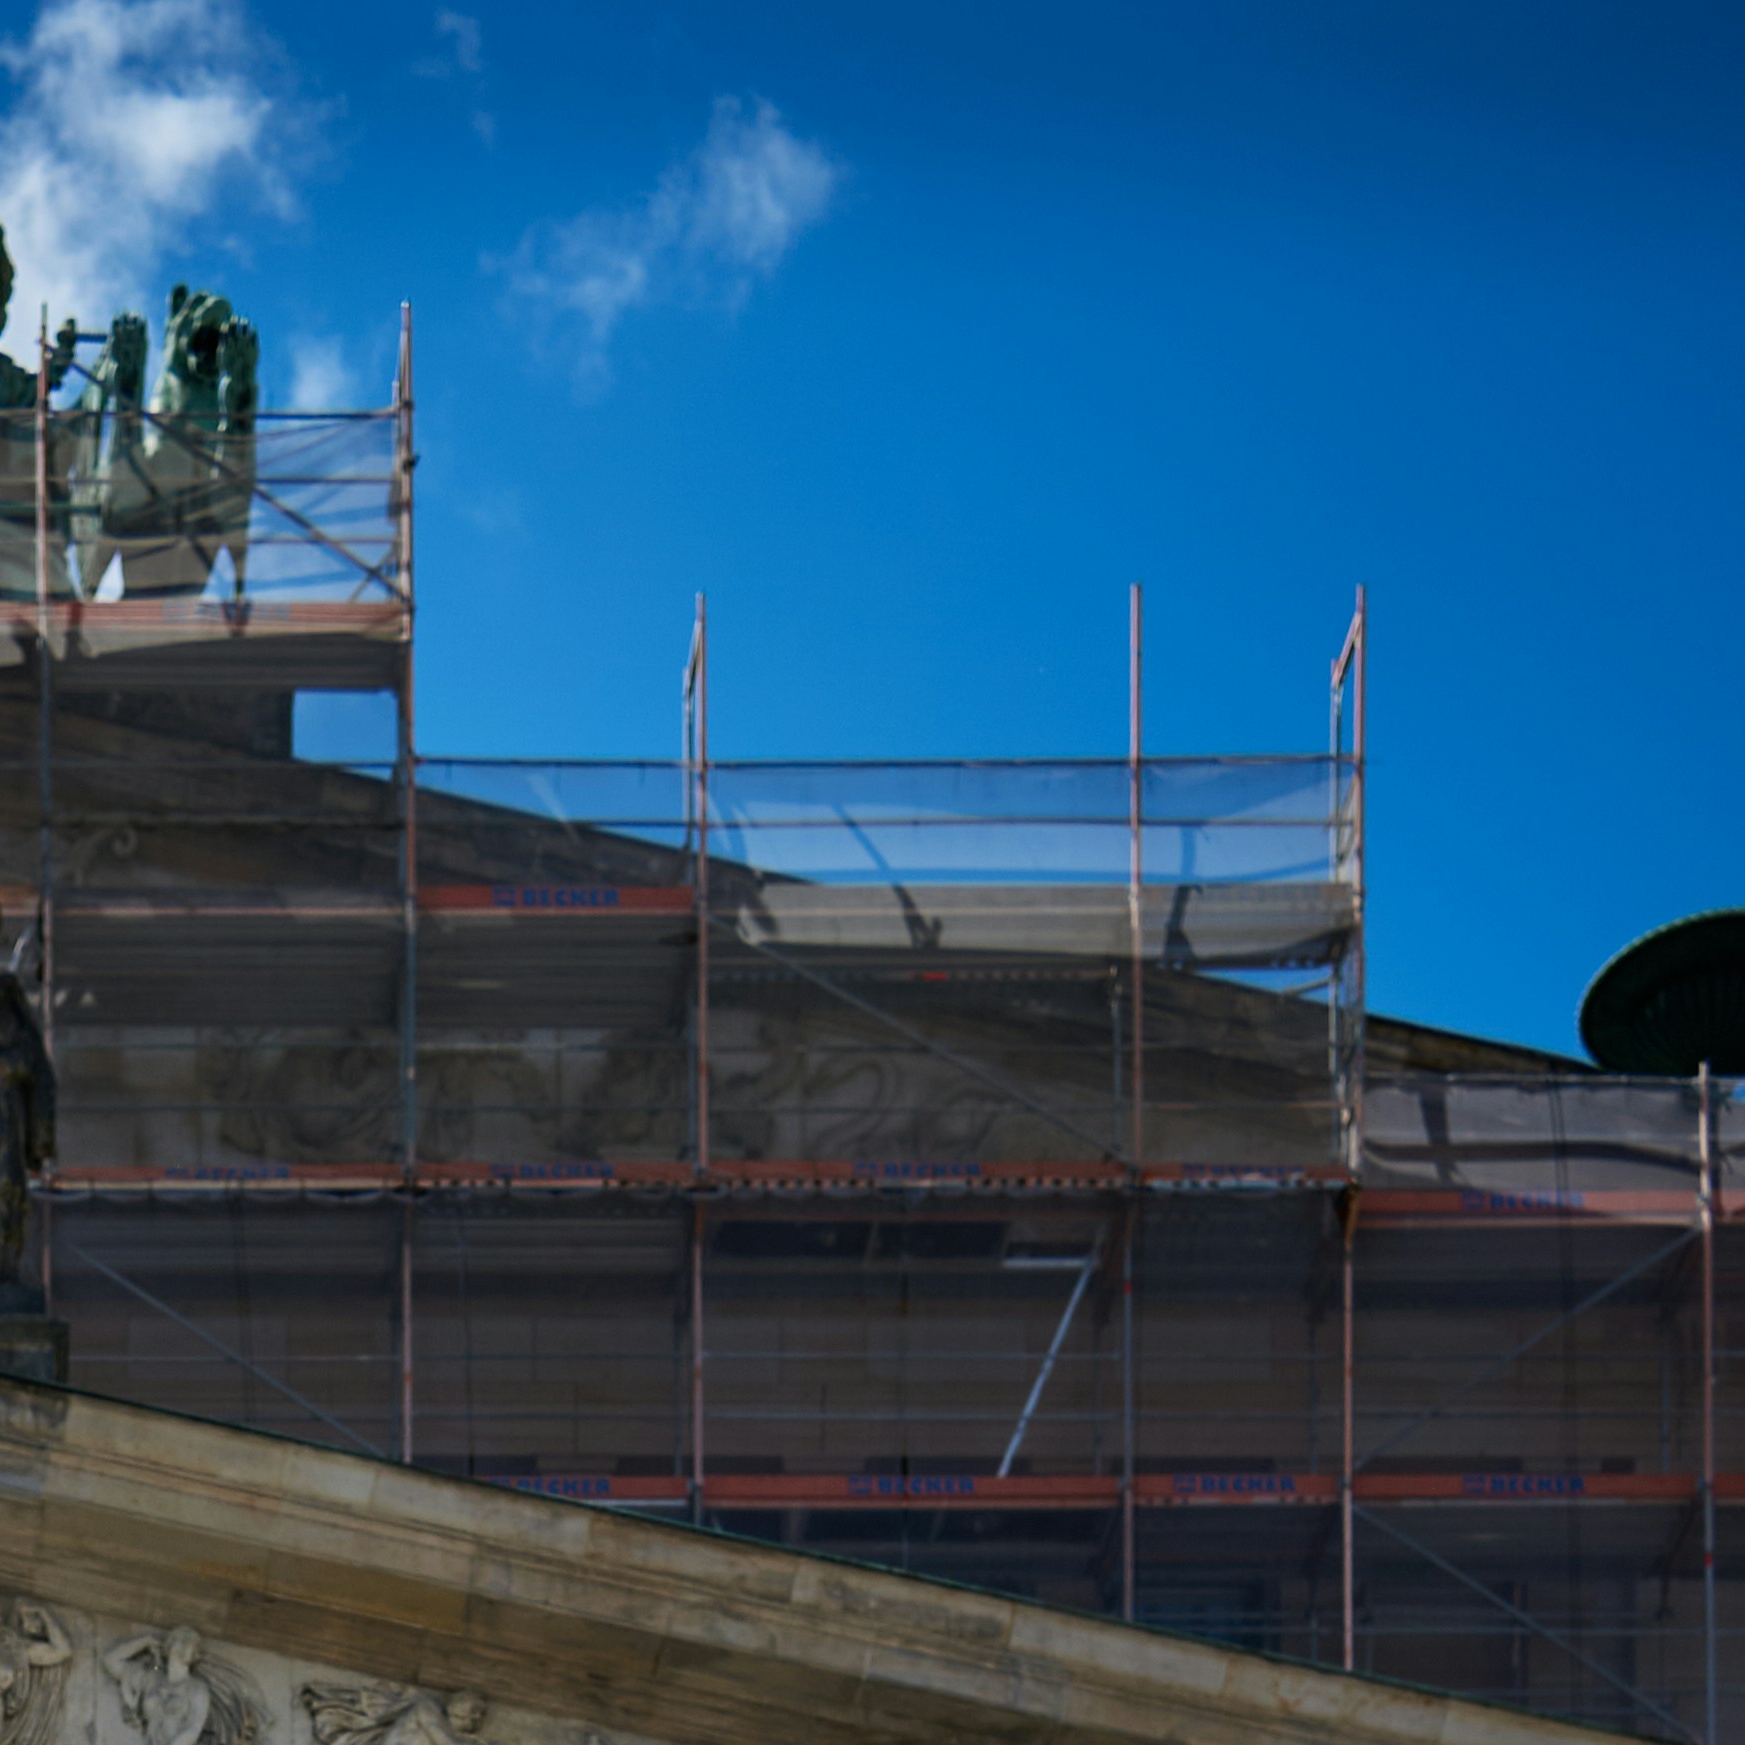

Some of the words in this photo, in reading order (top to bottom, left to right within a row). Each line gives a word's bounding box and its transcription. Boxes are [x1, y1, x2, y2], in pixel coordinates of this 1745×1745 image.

[522, 887, 619, 908] BECKER
[877, 1476, 975, 1495] BECKER
[1200, 1474, 1296, 1493] BECKER
[1491, 1475, 1586, 1494] BECKER
